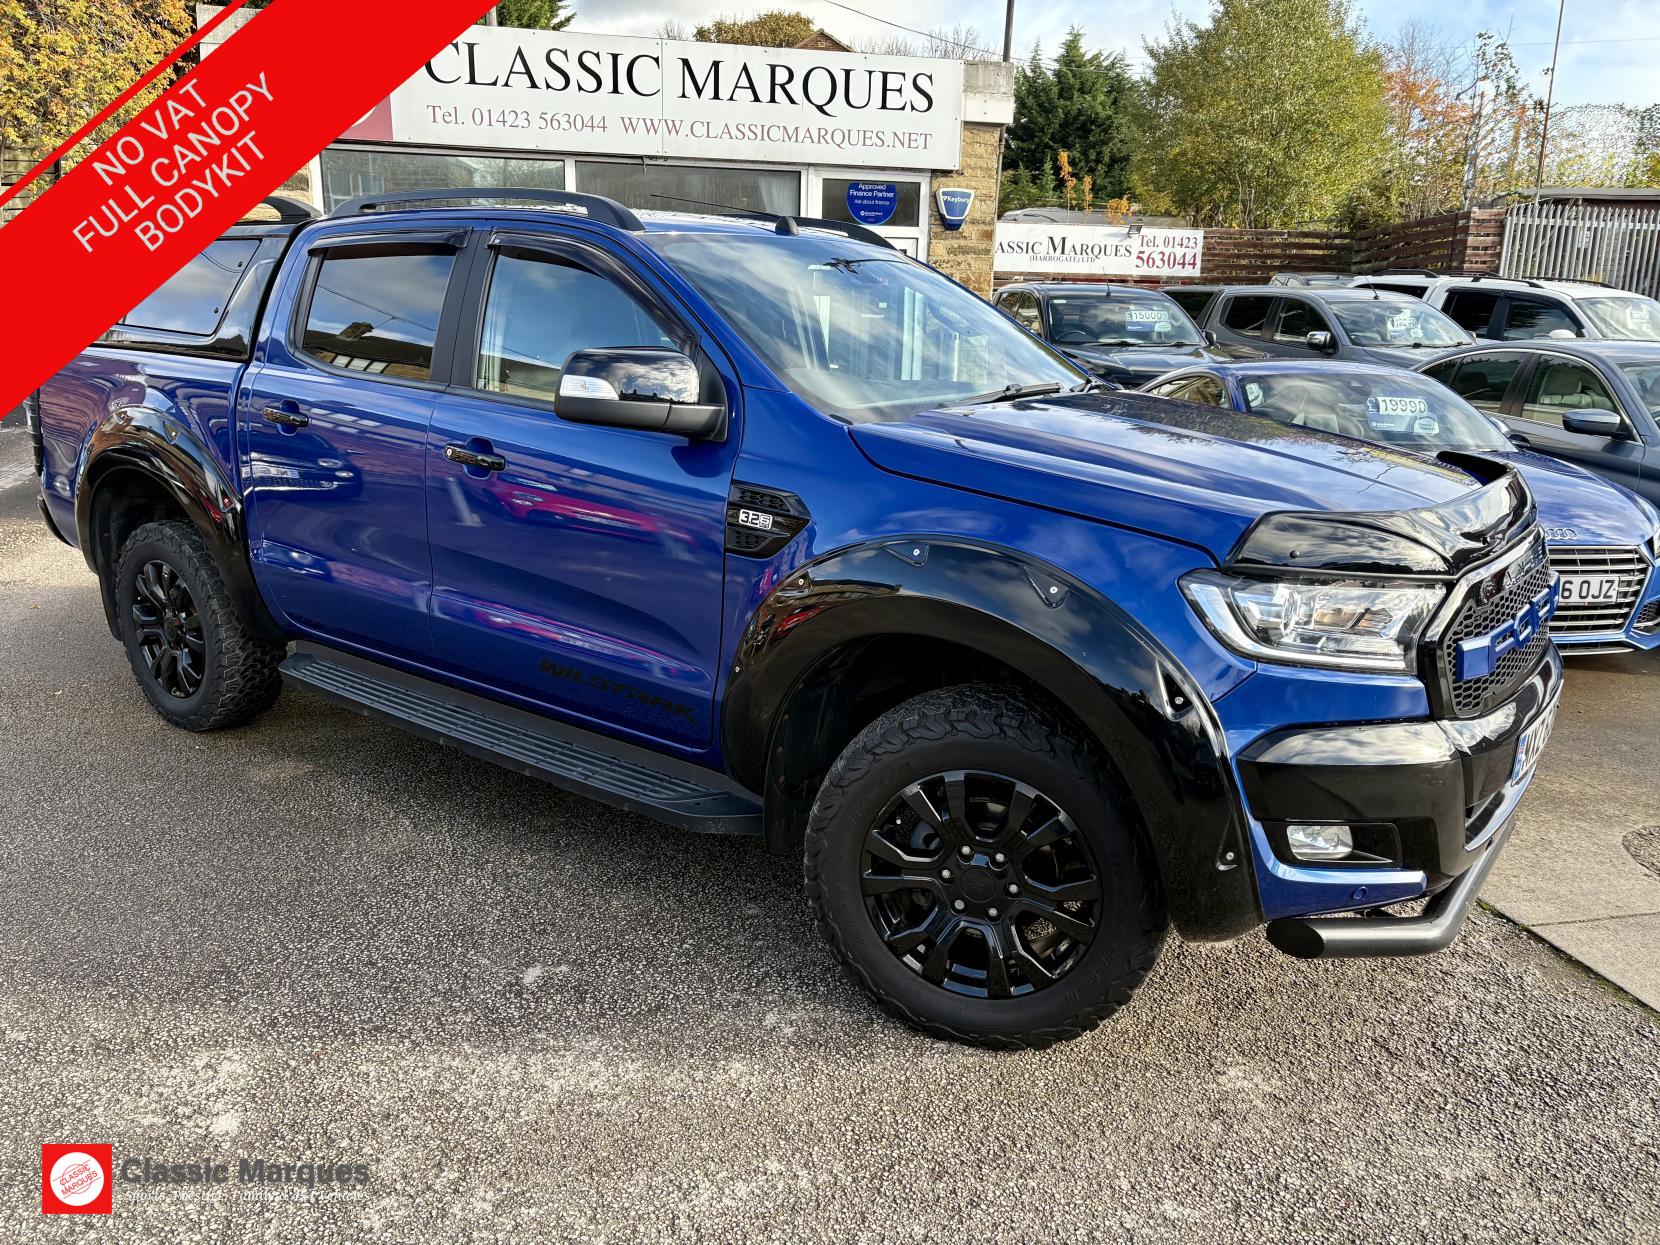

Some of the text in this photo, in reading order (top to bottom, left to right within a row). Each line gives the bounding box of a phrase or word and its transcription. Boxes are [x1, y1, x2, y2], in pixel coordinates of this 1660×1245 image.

[424, 41, 934, 118] CLASSIC MARQUES
[426, 105, 933, 150] Tel. 01423 563044 WWW.CLASSICMARQUES.NET
[849, 189, 872, 197] Finance
[858, 182, 886, 191] Approved
[1138, 234, 1198, 249] Tel. 01423
[1135, 250, 1198, 270] 563044
